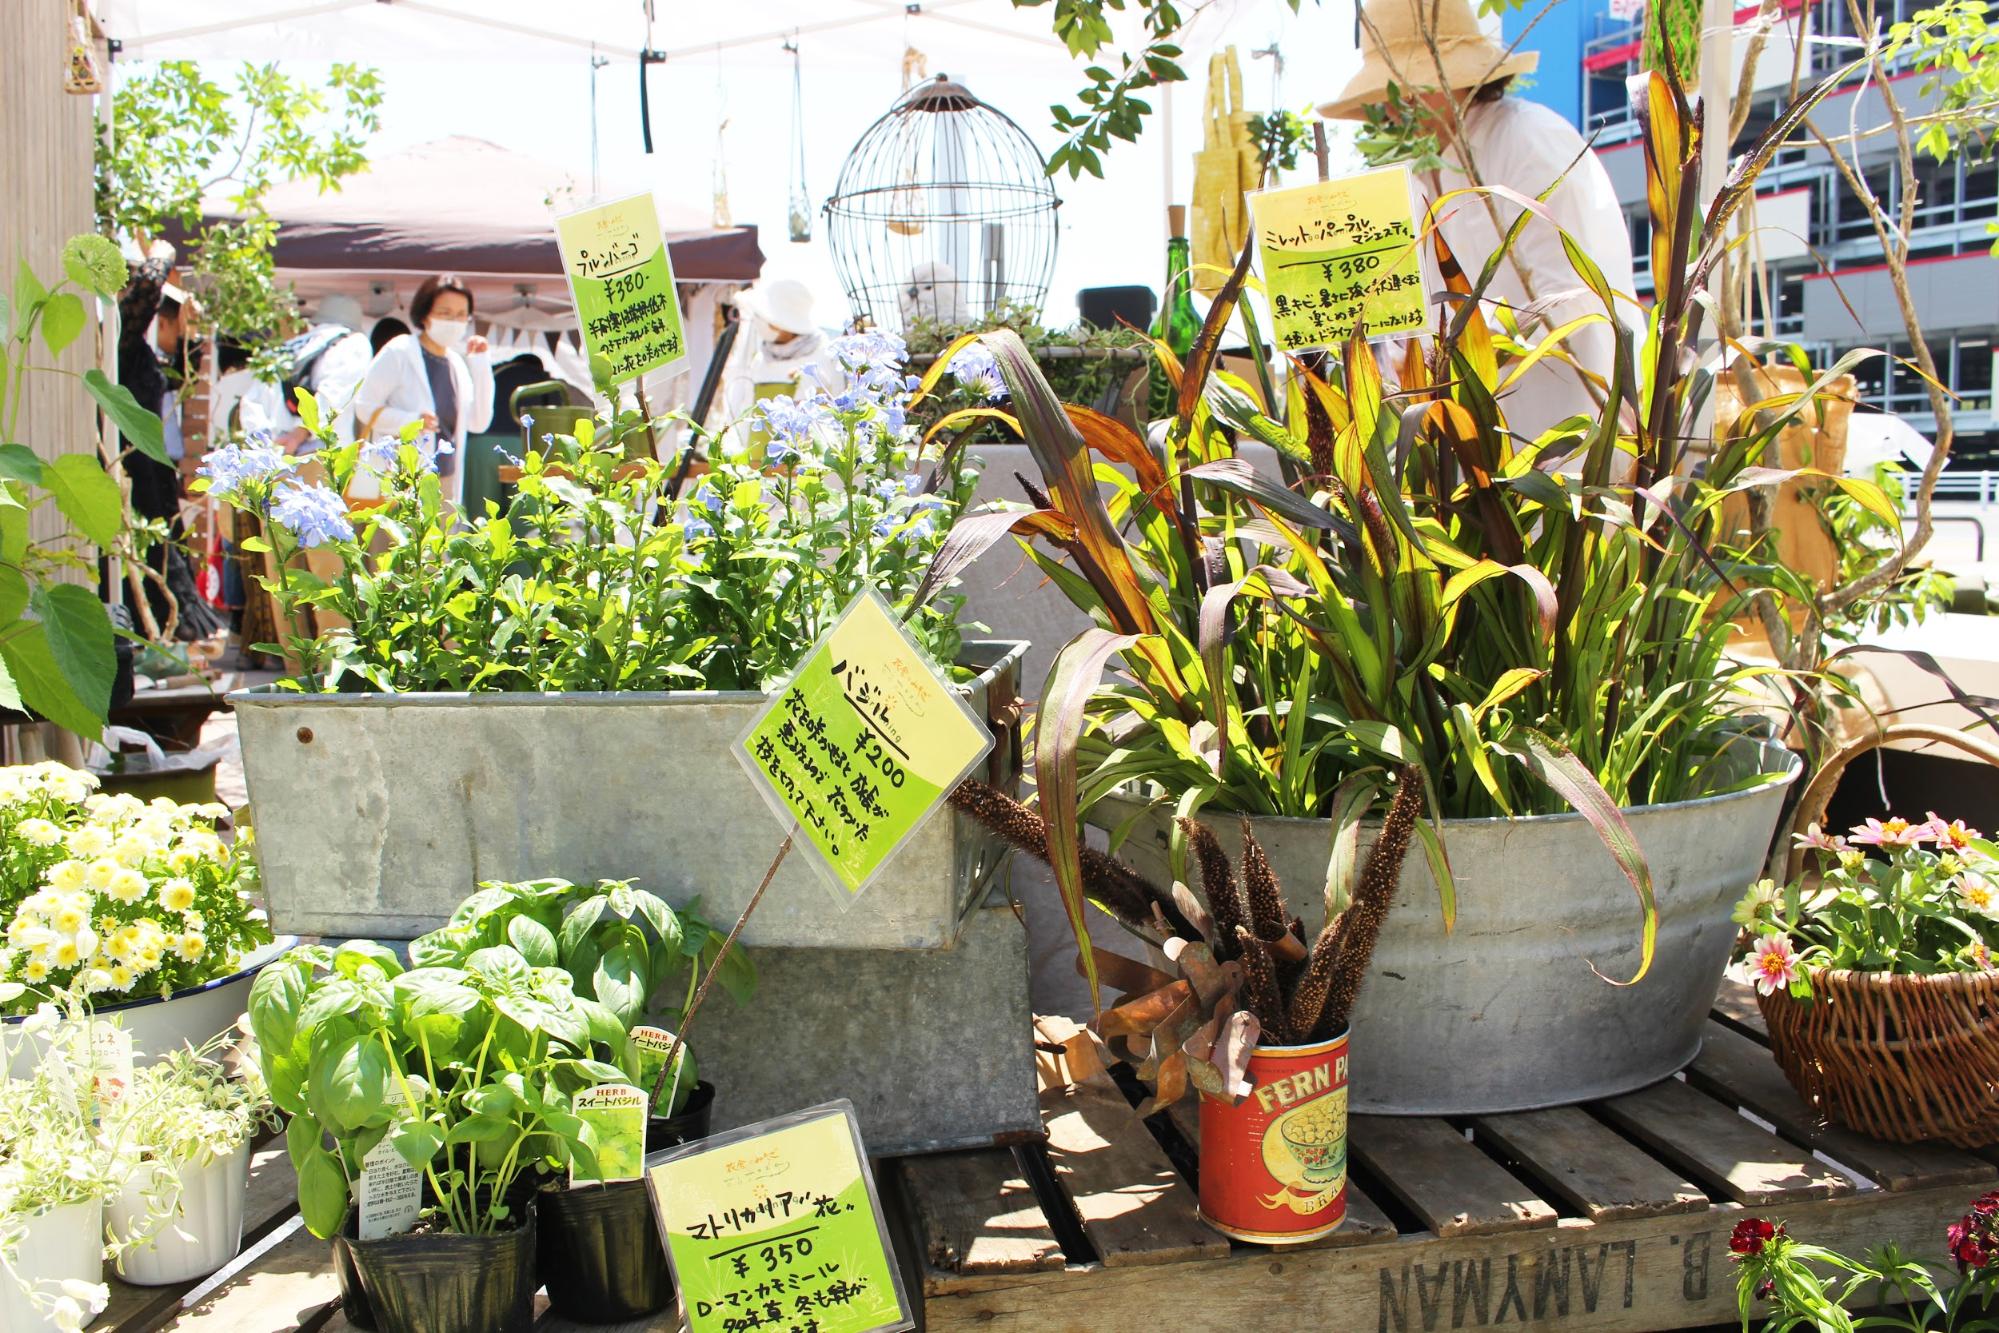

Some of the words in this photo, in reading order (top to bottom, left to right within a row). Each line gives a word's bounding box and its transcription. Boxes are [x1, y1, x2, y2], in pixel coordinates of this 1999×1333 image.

[577, 233, 640, 277] プルンバーゴ
[831, 659, 889, 723] バジル
[852, 728, 905, 788] ¥200
[631, 1036, 671, 1050] イートバジ
[641, 1029, 668, 1041] HERB
[578, 1096, 641, 1107] スイートバジル
[596, 1088, 627, 1097] HERB
[1254, 1063, 1330, 1114] FERN
[1378, 1240, 1636, 1333] LAMYMAN
